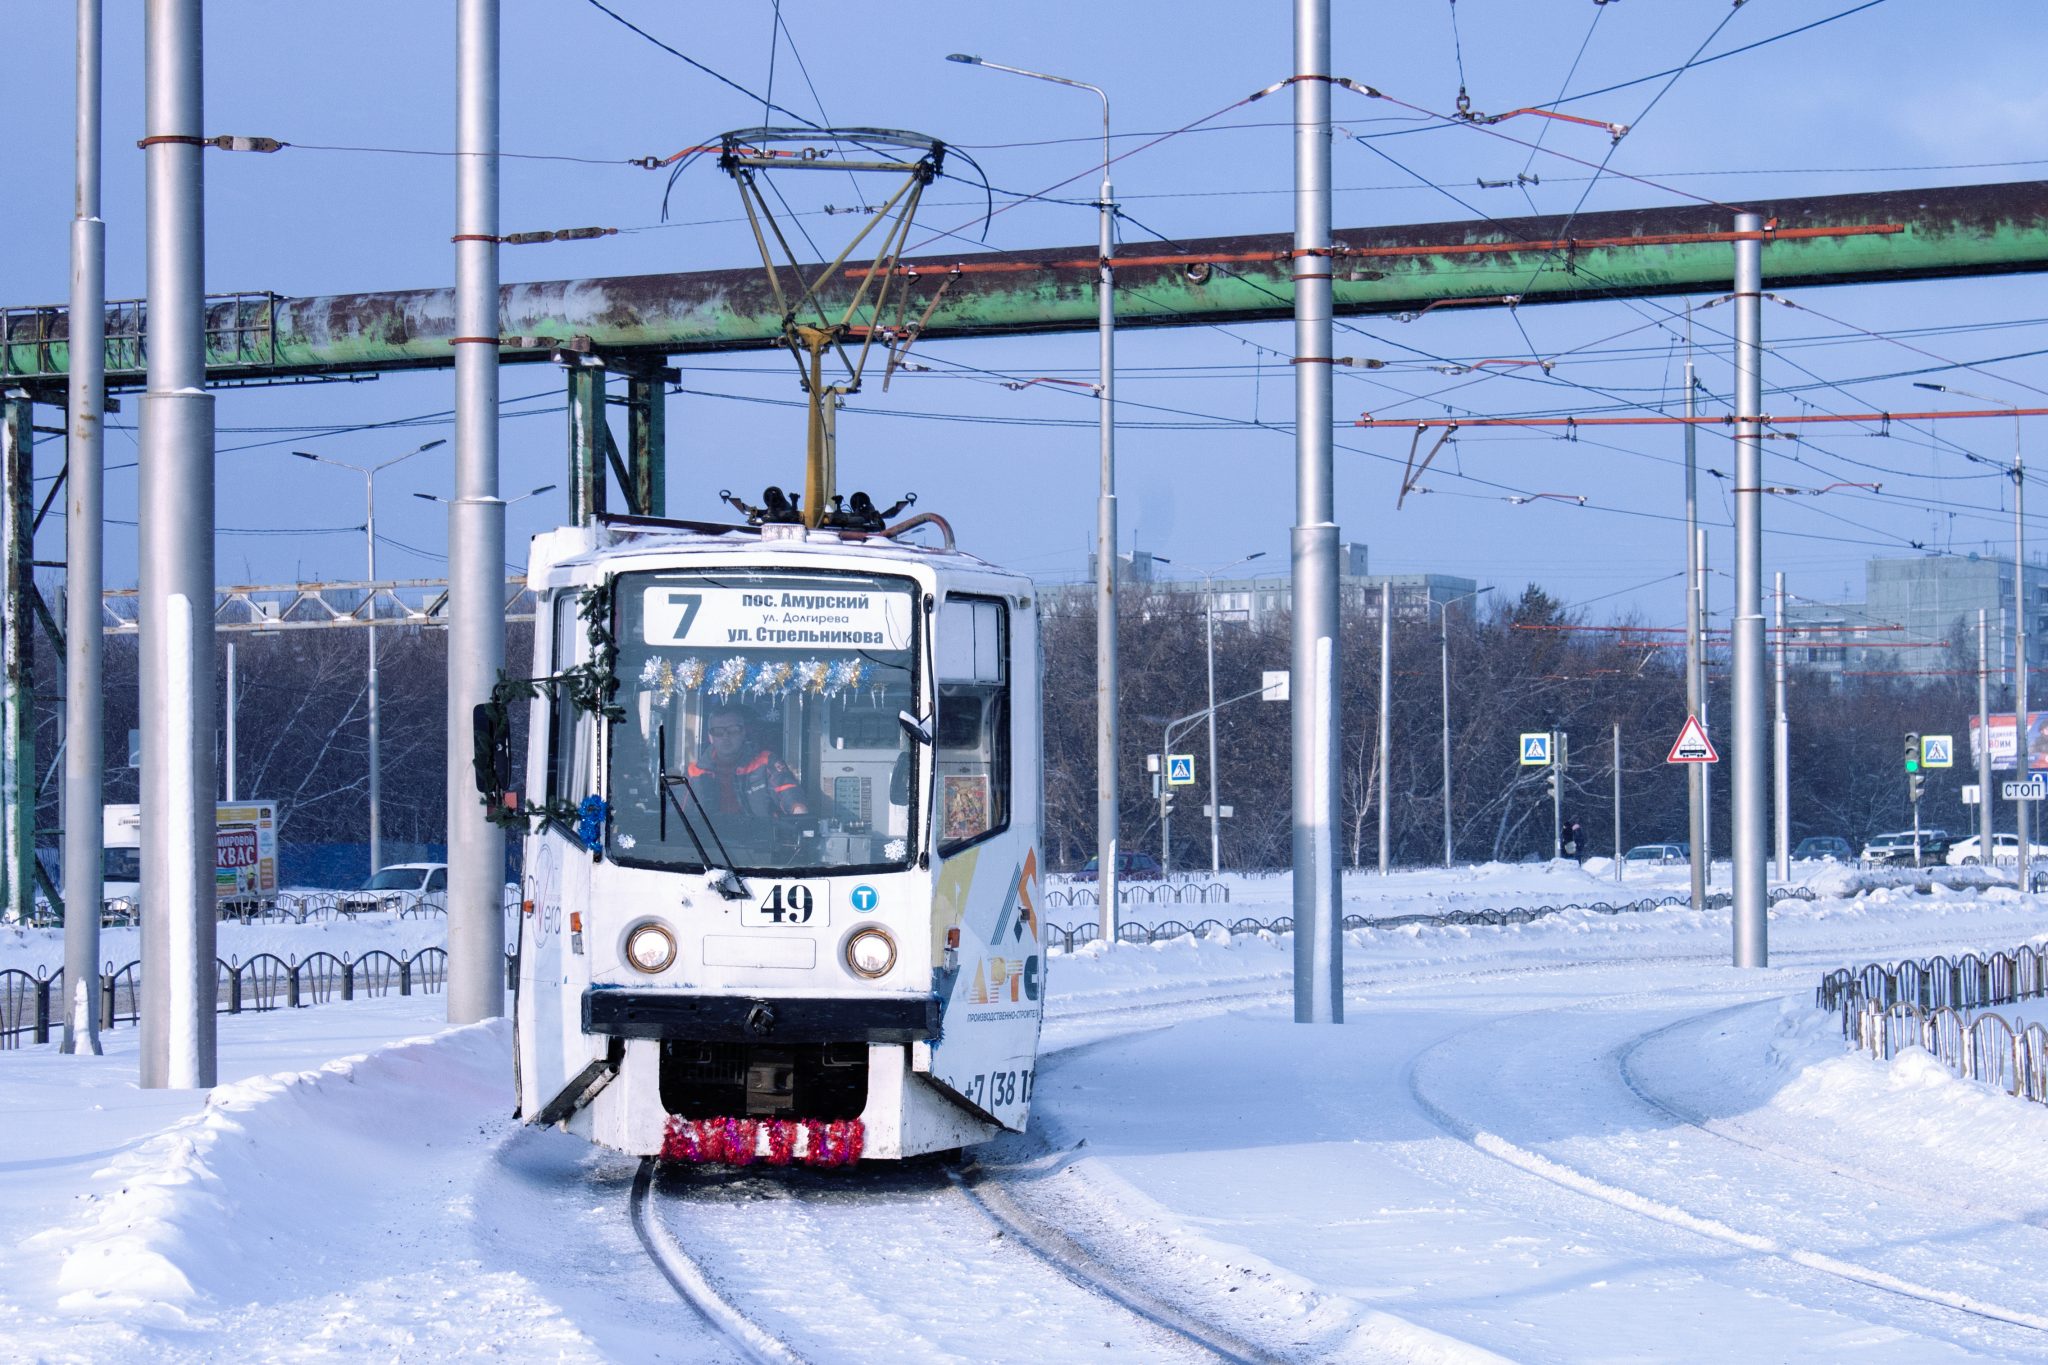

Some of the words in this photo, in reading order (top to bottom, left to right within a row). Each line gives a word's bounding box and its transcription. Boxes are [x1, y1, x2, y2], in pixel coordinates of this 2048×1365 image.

[742, 593, 778, 607] пос.
[781, 593, 869, 609] Амурский
[668, 593, 703, 639] 7
[762, 613, 779, 624] ул.
[782, 612, 850, 624] Долгирева
[727, 628, 753, 642] ул.
[756, 627, 884, 643] Стрельникова
[2005, 784, 2040, 797] СТОП
[218, 834, 255, 847] МИРОВОЙ
[217, 847, 255, 865] КВАС
[760, 884, 813, 923] 49
[965, 1074, 986, 1107] +7
